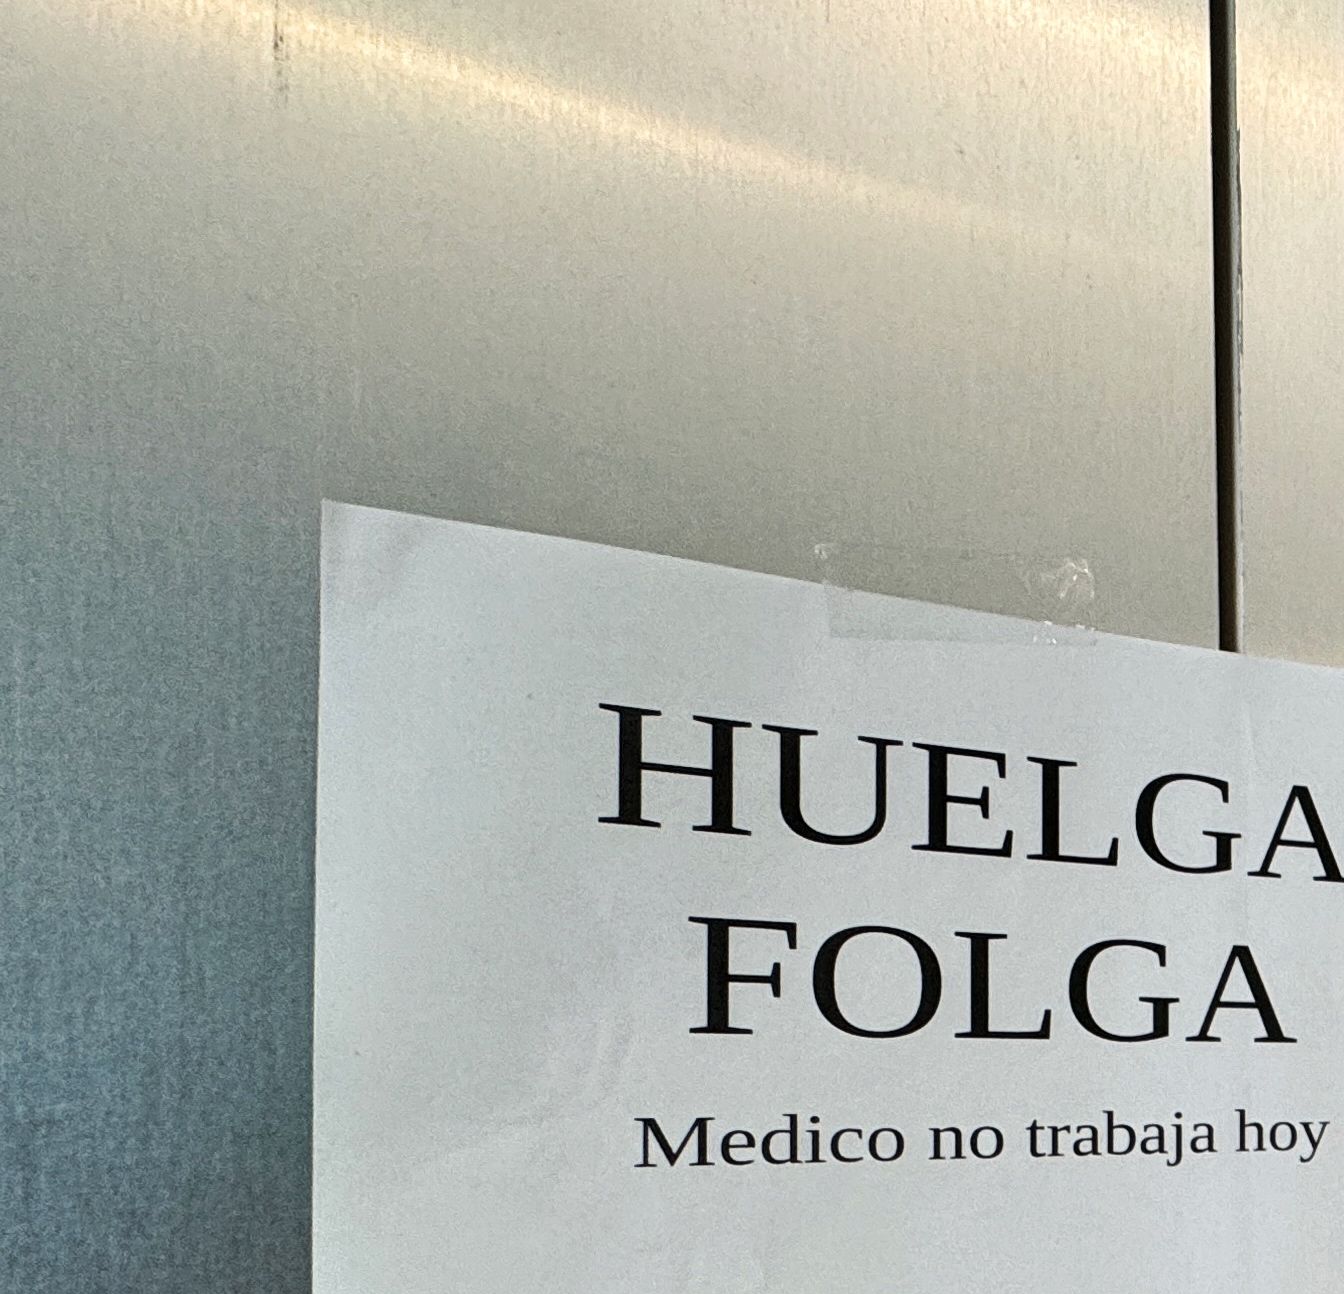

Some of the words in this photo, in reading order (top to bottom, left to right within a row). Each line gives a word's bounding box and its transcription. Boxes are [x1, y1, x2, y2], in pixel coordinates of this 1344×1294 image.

[687, 916, 1298, 1044] FOLGA
[634, 1113, 905, 1168] Medico
[929, 1126, 1004, 1160] no
[1026, 1110, 1217, 1167] trabaja
[1235, 1108, 1330, 1163] hoy
